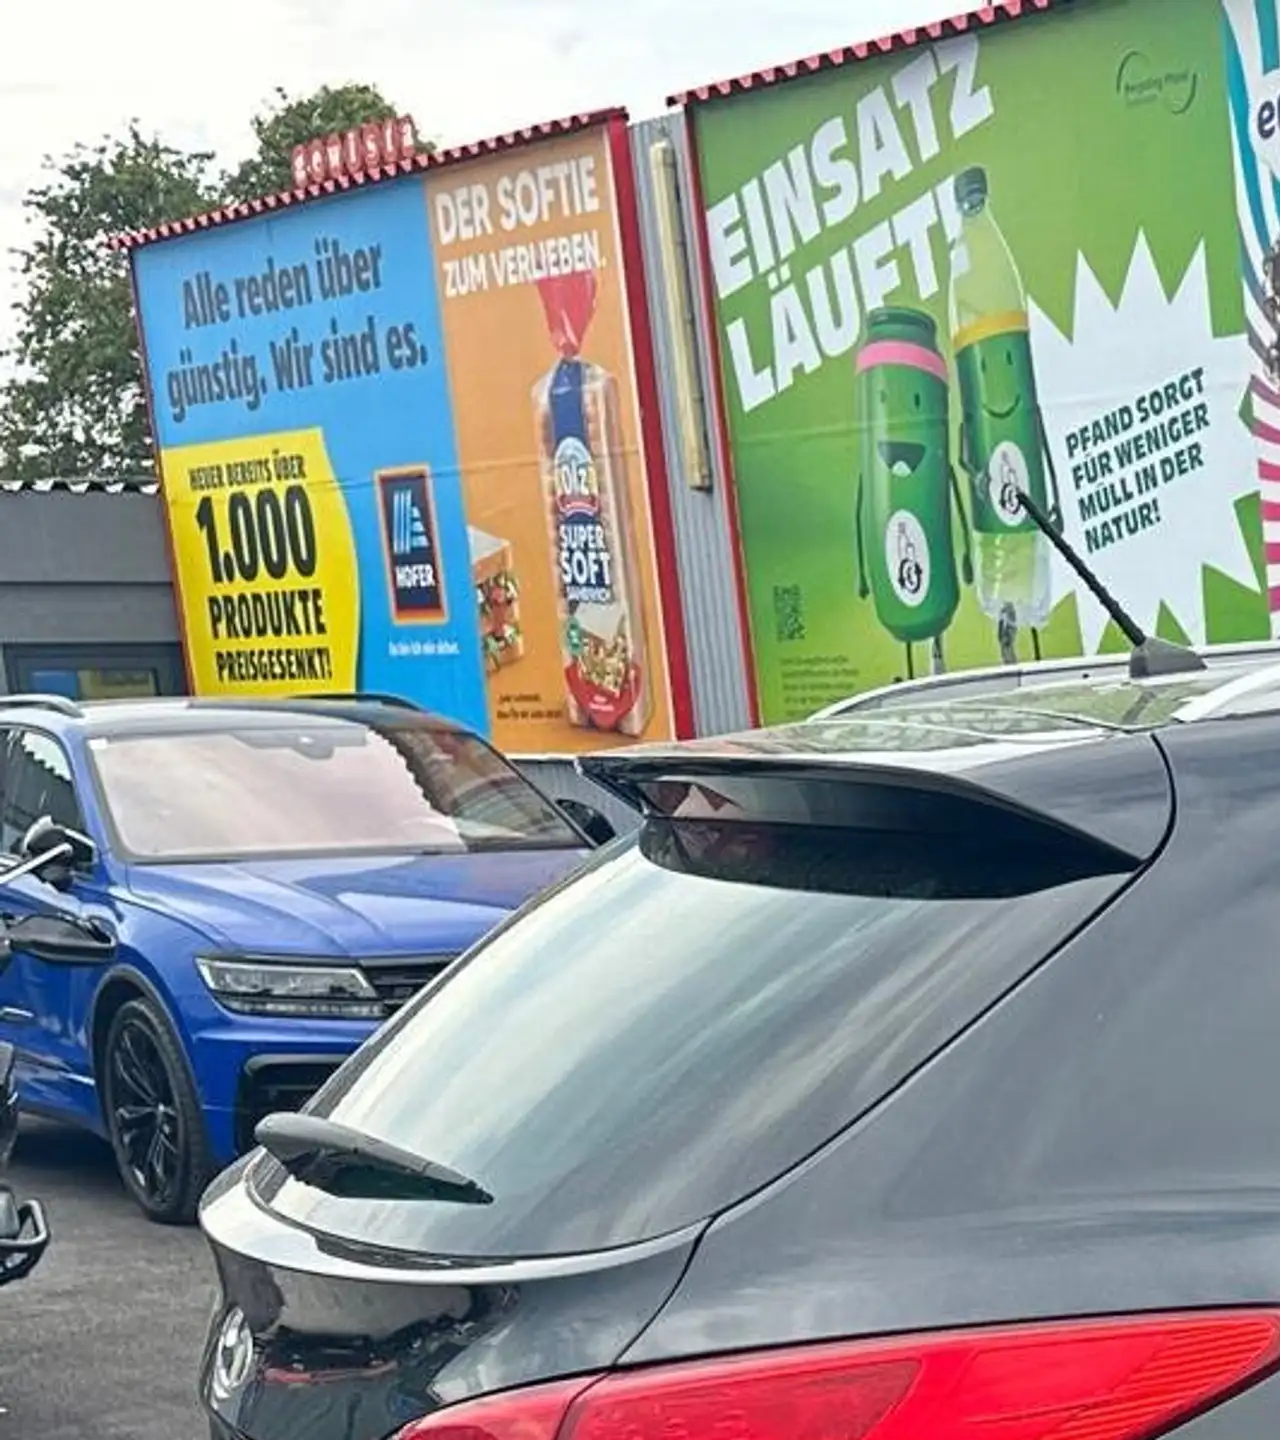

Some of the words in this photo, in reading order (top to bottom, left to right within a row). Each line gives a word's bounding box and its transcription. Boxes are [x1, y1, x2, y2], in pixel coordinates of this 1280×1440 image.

[435, 183, 493, 246] DER
[496, 155, 600, 231] SOFTIE
[706, 33, 994, 298] EINSATZ
[182, 269, 231, 330] Alle
[234, 255, 313, 319] reden
[315, 236, 382, 301] über
[442, 252, 488, 298] ZUM
[490, 229, 608, 287] VERLIEBEN.
[726, 174, 970, 412] LÄUFT!
[167, 337, 269, 423] günstig.
[269, 326, 314, 393] Wir
[319, 314, 381, 384] sind
[386, 320, 429, 371] es.
[1065, 405, 1135, 459] PFAND
[1135, 366, 1205, 423] SORGT
[1071, 451, 1114, 490] FÜR
[1113, 402, 1211, 470] WENIGER
[1078, 477, 1134, 523] MÜLL
[1134, 463, 1159, 495] IN
[1159, 442, 1205, 484] DER
[195, 485, 318, 583] 1.000
[559, 523, 606, 550] SUPER
[560, 550, 611, 585] SOFT
[1084, 497, 1162, 554] NATUR!
[208, 588, 328, 640] PRODUKTE
[395, 563, 436, 589] HOFER
[216, 646, 333, 684] PREISGESENKT!
